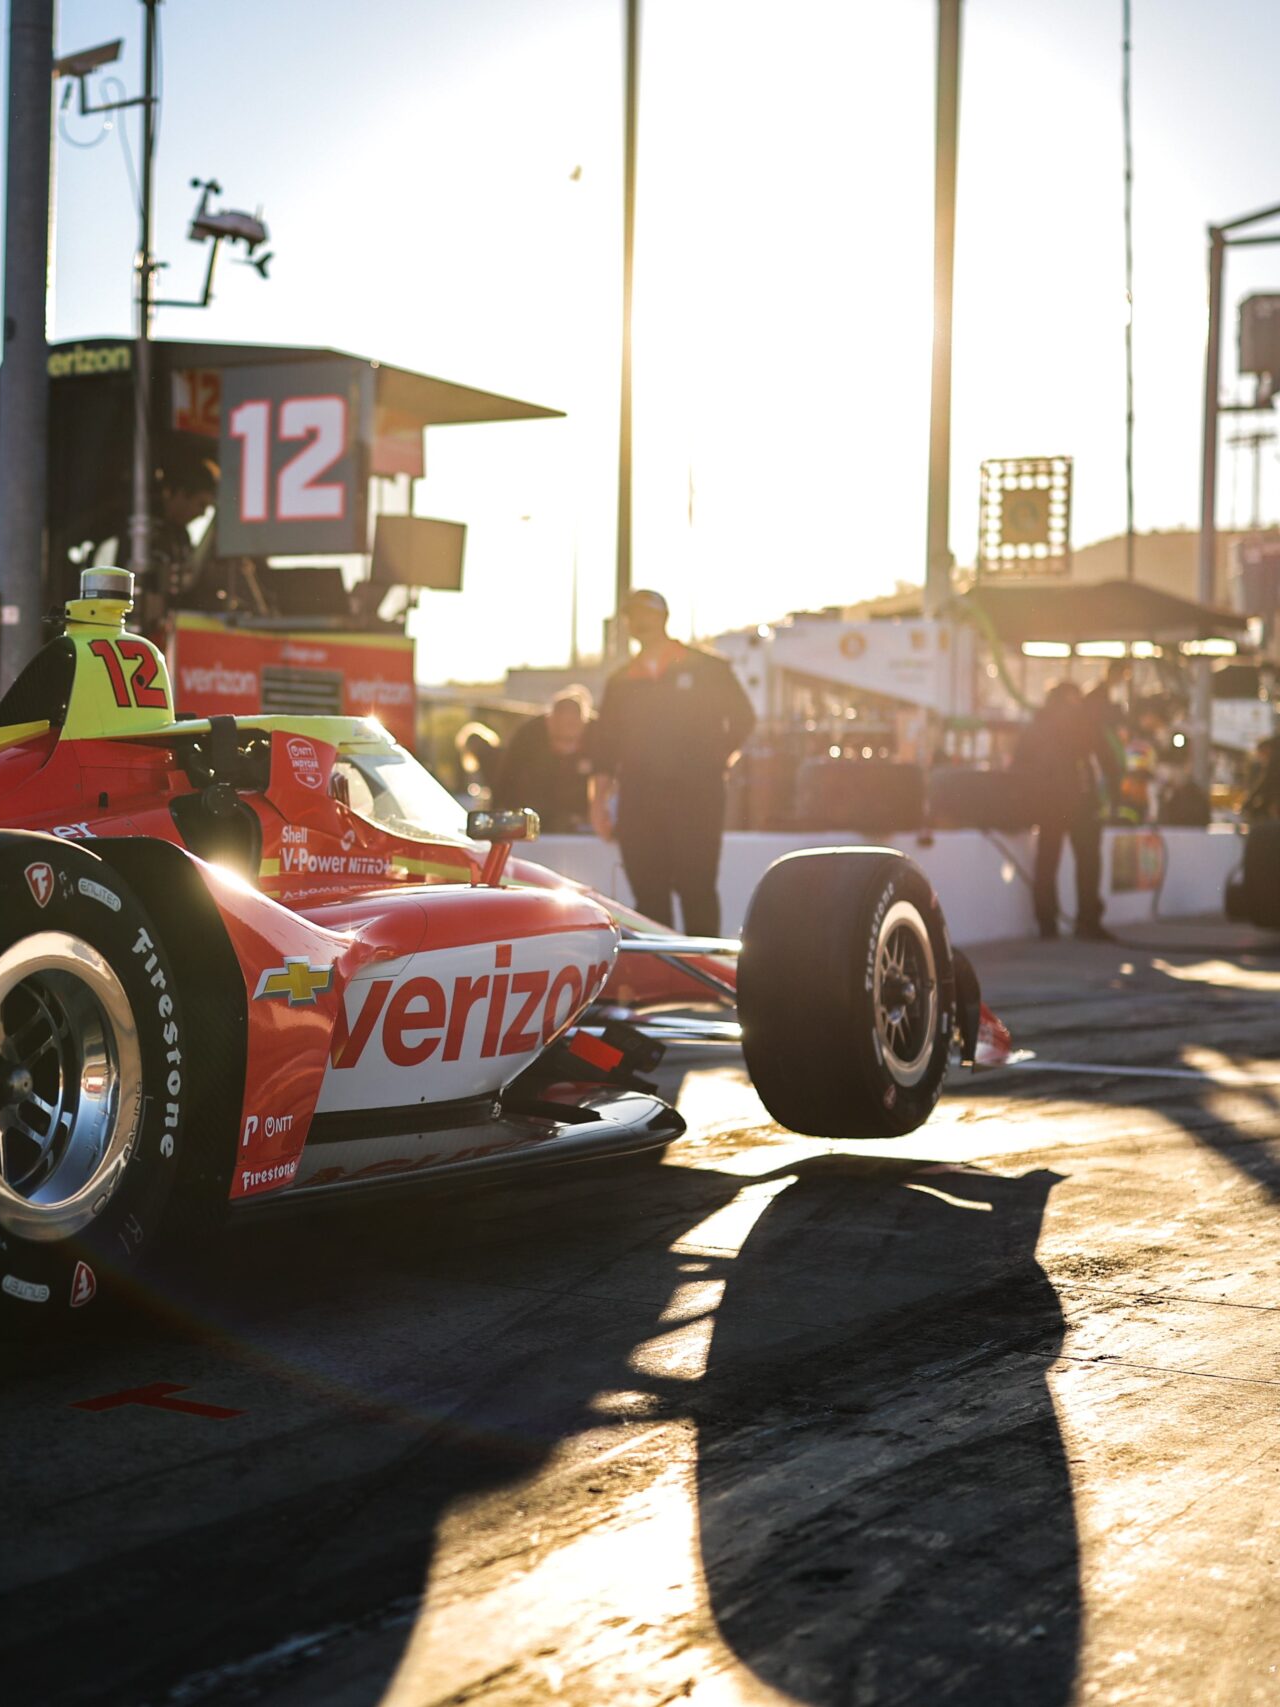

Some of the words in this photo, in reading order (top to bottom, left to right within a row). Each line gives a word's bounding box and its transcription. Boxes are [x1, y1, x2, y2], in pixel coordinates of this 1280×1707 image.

[48, 344, 130, 378] erizon
[229, 395, 348, 522] 12
[87, 638, 169, 710] 12
[180, 662, 257, 696] verizon
[347, 677, 413, 705] verizon
[282, 824, 308, 844] Shell
[282, 847, 347, 873] V-Power
[131, 927, 183, 1160] Firestone
[241, 1160, 297, 1193] Firestone
